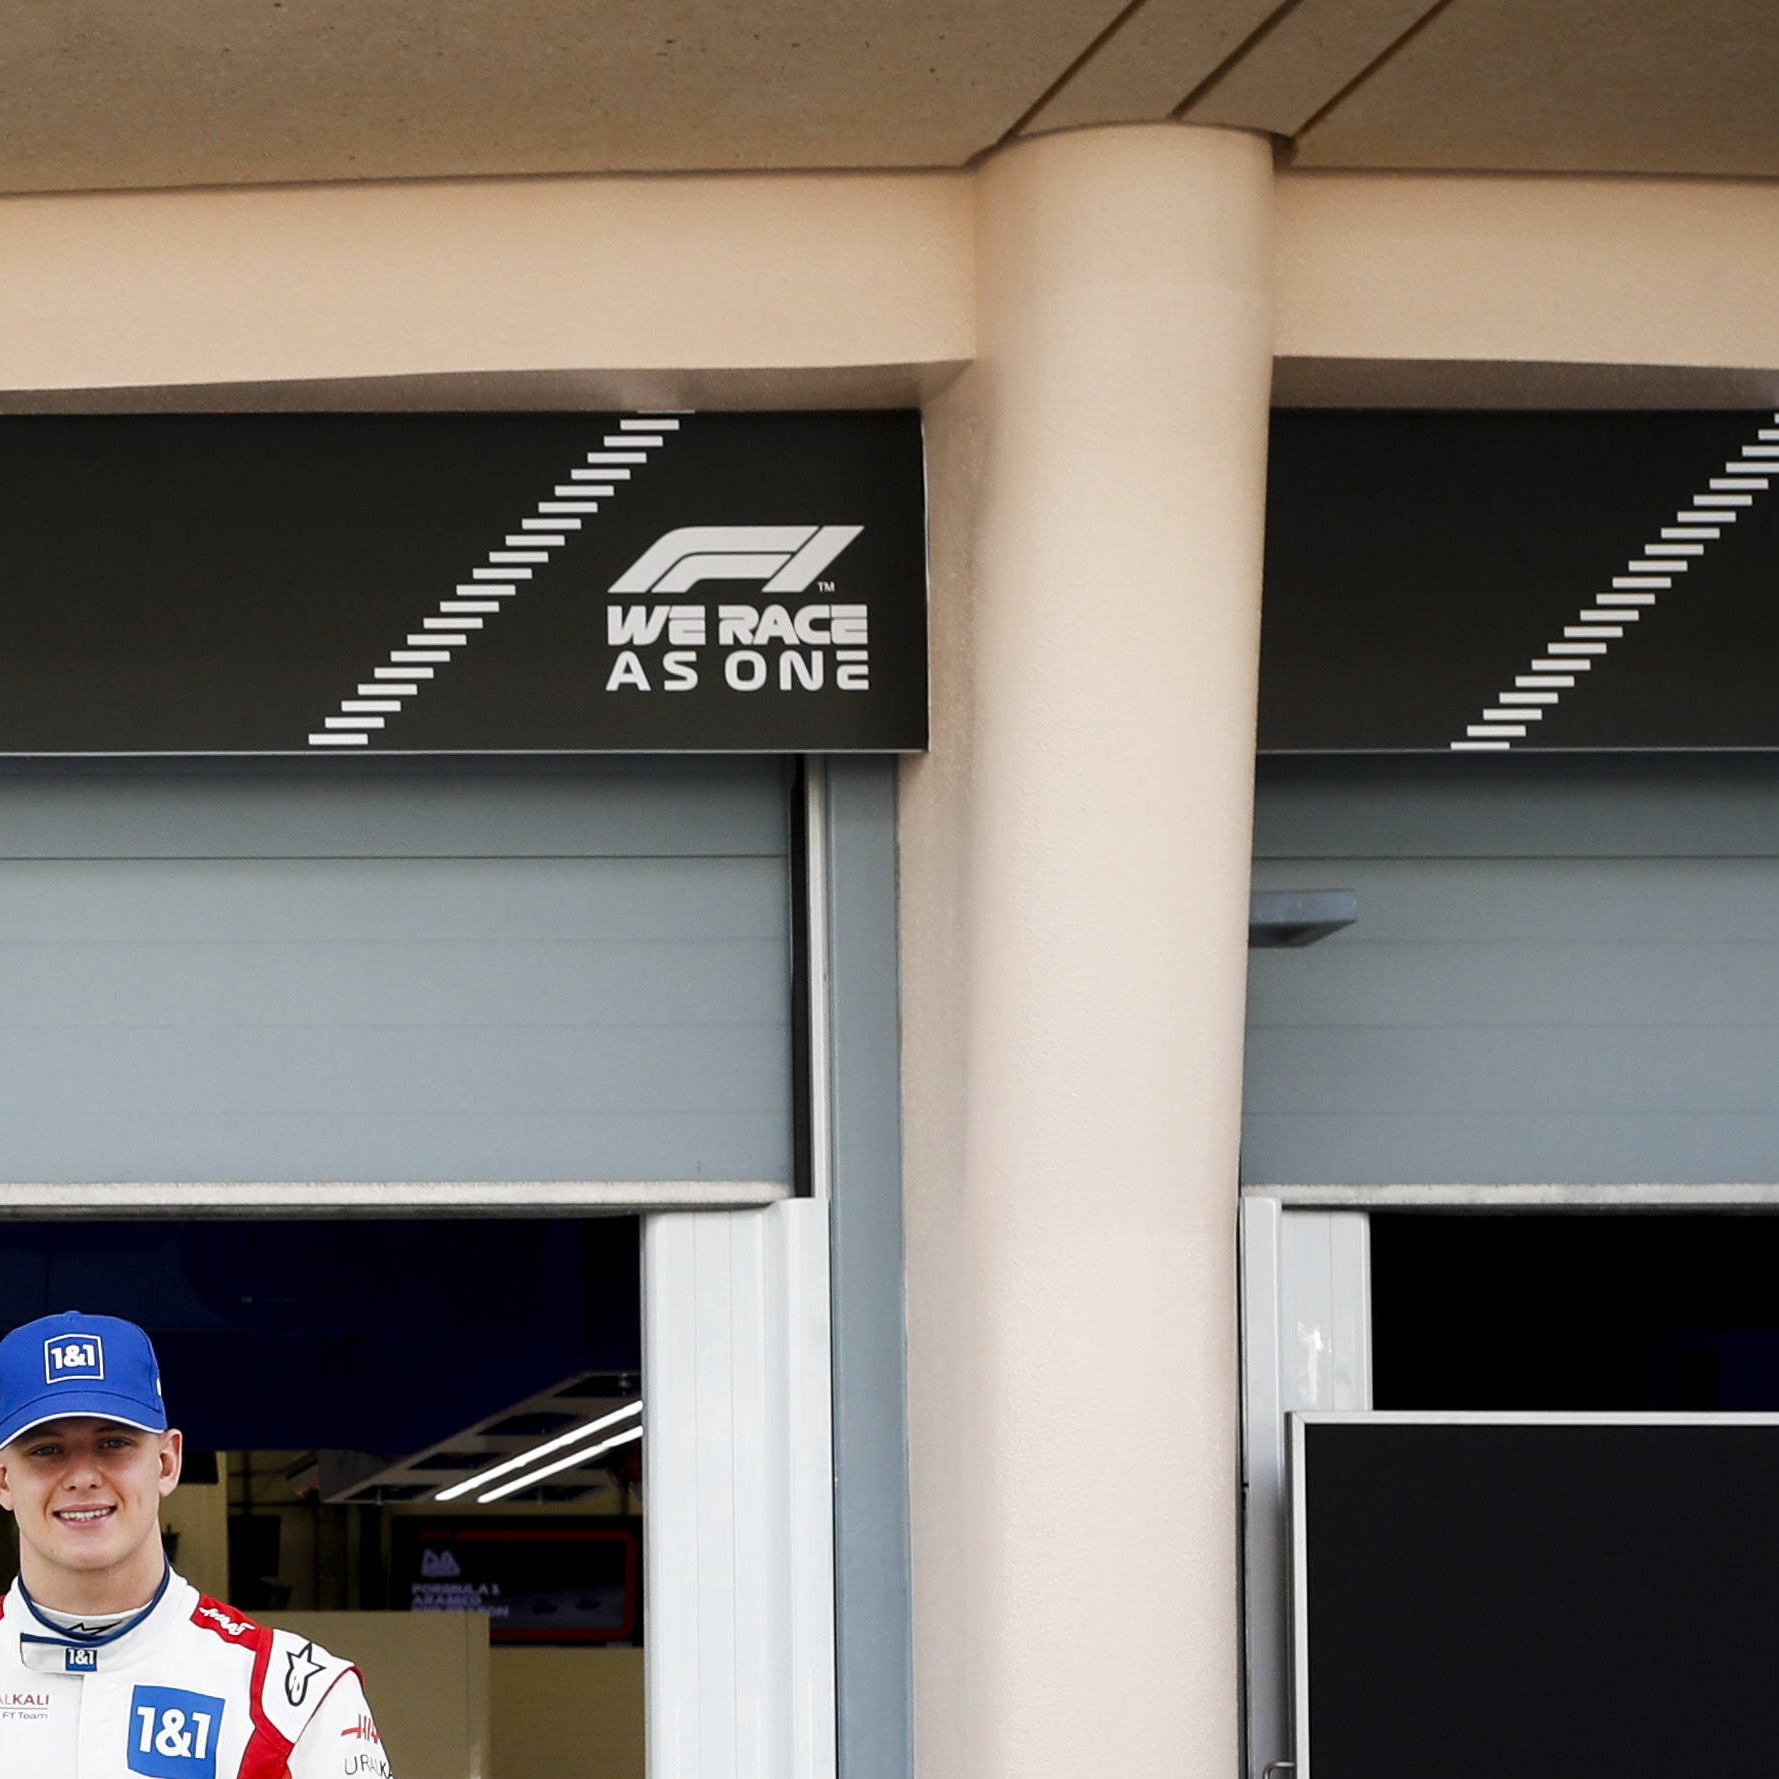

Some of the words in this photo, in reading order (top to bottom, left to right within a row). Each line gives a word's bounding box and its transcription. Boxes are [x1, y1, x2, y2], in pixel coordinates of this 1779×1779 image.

[606, 604, 706, 646] WE
[718, 604, 869, 646] RACE
[604, 649, 699, 692] AS
[724, 649, 870, 692] ONE
[50, 1344, 96, 1370] 1&1
[68, 1649, 94, 1665] 1&1
[136, 1705, 211, 1759] 1&1
